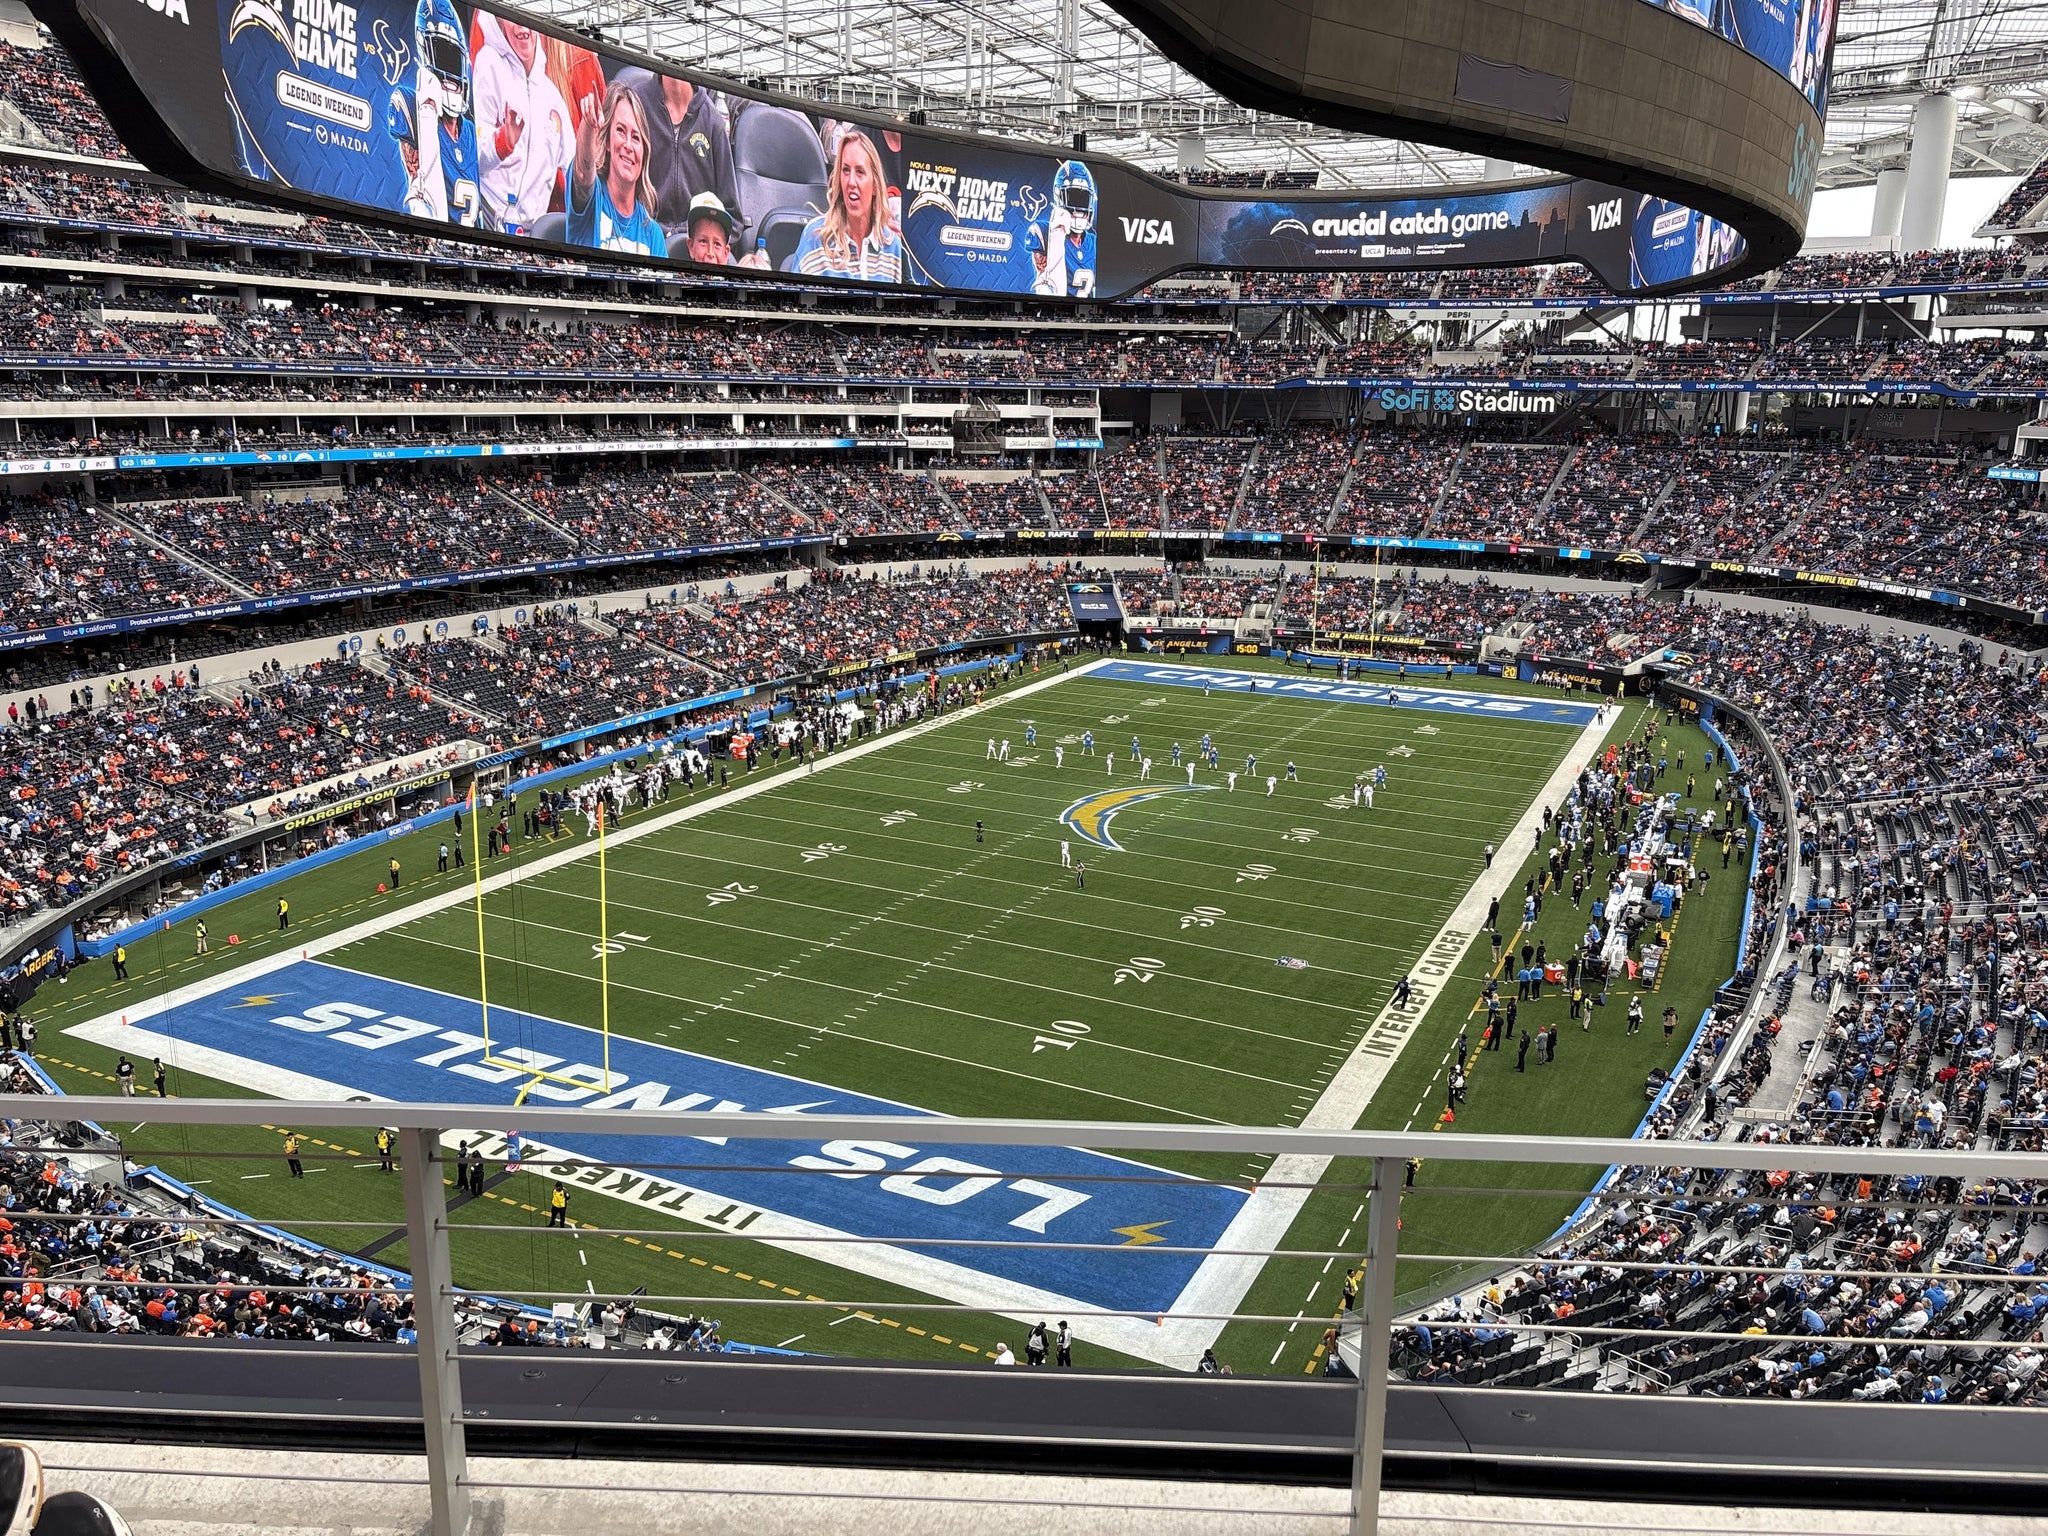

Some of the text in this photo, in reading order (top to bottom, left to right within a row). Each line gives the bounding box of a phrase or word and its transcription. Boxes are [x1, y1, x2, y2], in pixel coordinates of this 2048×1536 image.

[293, 0, 357, 43] HOME
[295, 21, 357, 79] GAME
[362, 41, 376, 55] VS
[286, 83, 363, 120] LEGENDS WEEKEND
[331, 132, 369, 153] MAZDA
[909, 161, 925, 171] NOV.
[907, 169, 1008, 203] NEXT HOME
[957, 197, 1006, 222] GAME
[1587, 198, 1622, 231] VISA
[1119, 217, 1175, 245] VISA
[1311, 207, 1508, 238] crucial catch game
[947, 231, 1006, 245] LEGENDS WEEKEND
[978, 254, 1008, 264] MAZDA
[1386, 246, 1411, 256] Health
[1849, 292, 1862, 300] your
[1862, 291, 1880, 299] shield.
[1447, 311, 1471, 319] PEPSI
[1540, 310, 1565, 318] PEPSI
[1380, 388, 1555, 412] SoFi Stadium
[0, 462, 9, 473] 4
[44, 461, 51, 471] 4
[80, 459, 86, 469] 0
[1017, 531, 1079, 539] 50/50 RAFFLE
[1110, 531, 1129, 539] RAFFLE
[1130, 531, 1148, 539] TICKET
[1710, 562, 1780, 576] 50/50 RAFFLE
[1796, 571, 1810, 581] BUY
[1810, 573, 1815, 581] A
[1816, 574, 1837, 584] RAFFLE
[1837, 576, 1858, 586] TICKET
[1885, 583, 1907, 595] CHANCE
[1908, 586, 1915, 596] TO
[273, 597, 299, 606] california
[310, 593, 328, 601] Protect
[329, 591, 341, 599] what
[130, 618, 153, 626] Protect
[153, 615, 169, 623] what
[170, 612, 194, 620] matters.
[212, 608, 225, 616] your
[225, 604, 242, 613] shield.
[10, 638, 25, 647] your
[26, 633, 47, 643] shield.
[63, 622, 116, 637] blue california
[1344, 632, 1380, 642] ANGELES
[1382, 634, 1426, 646] CHARGERS
[1168, 640, 1208, 648] ANGELES
[828, 651, 917, 676] LOS ANGELES CHARGERS
[1503, 666, 1516, 678] 20
[1143, 668, 1533, 713] CHARGERS
[947, 780, 985, 793] 50
[284, 771, 451, 831] CHARGERS.COM/TICKETS
[880, 809, 919, 827] 40
[1281, 827, 1320, 843] 50
[800, 842, 848, 863] 30
[1236, 864, 1277, 883] 40
[706, 881, 760, 907] 20
[1181, 906, 1227, 929] 30
[591, 930, 652, 959] 10
[1424, 929, 1472, 977] CANCER
[1114, 956, 1166, 984] 20
[1361, 976, 1438, 1059] INTERCEPT
[1032, 1019, 1092, 1053] 10
[549, 1157, 695, 1212] TAKES
[787, 1139, 1093, 1234] LOS
[705, 1200, 763, 1231] IT
